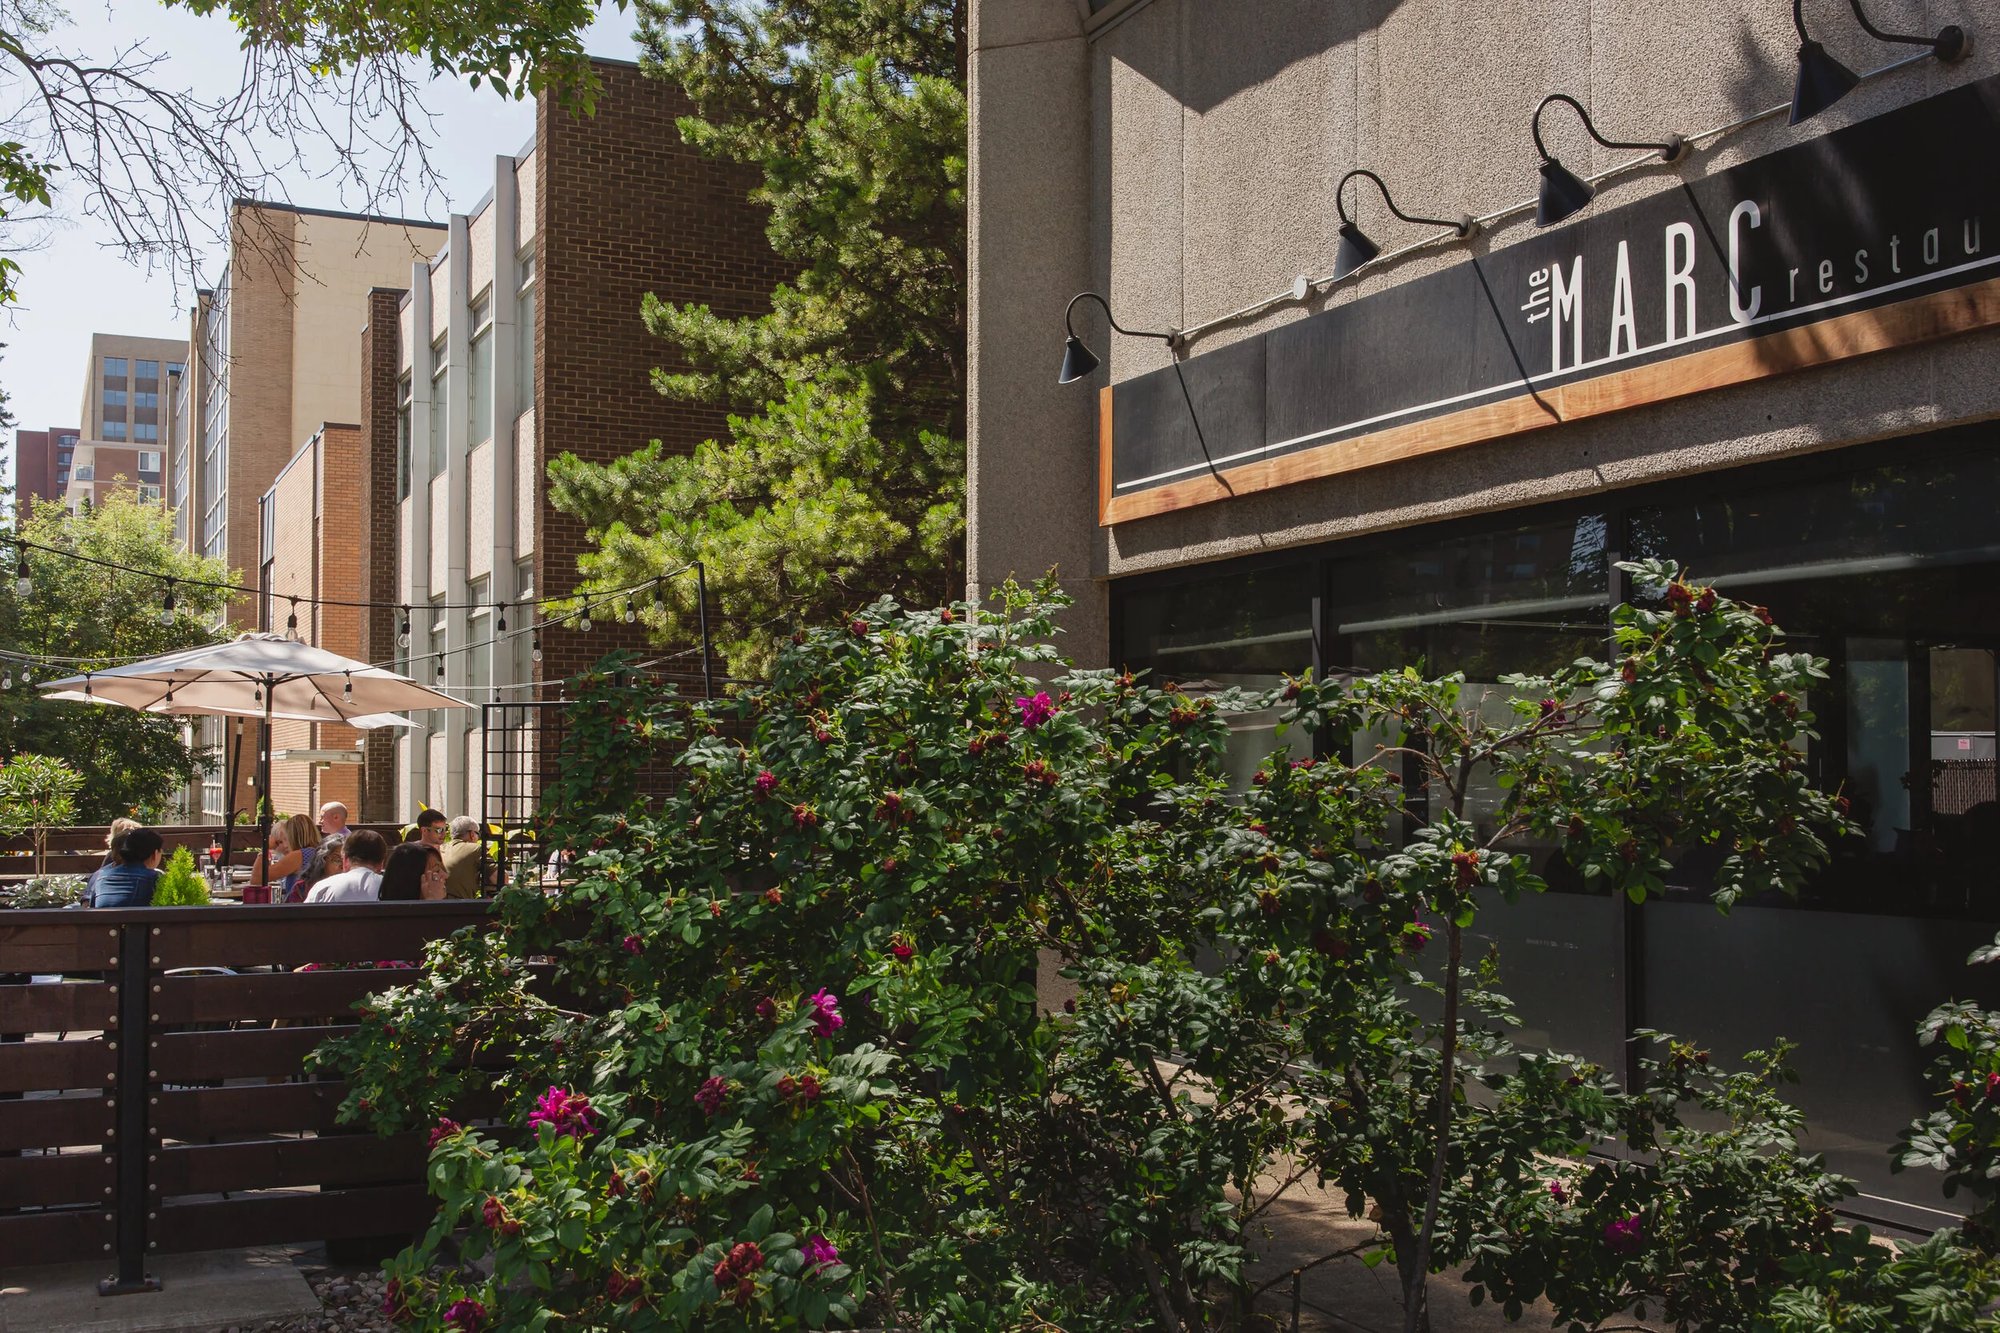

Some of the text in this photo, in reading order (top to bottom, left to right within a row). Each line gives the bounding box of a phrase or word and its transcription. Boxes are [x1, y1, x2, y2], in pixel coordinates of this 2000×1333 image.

[1521, 200, 1981, 374] the MARC restau
